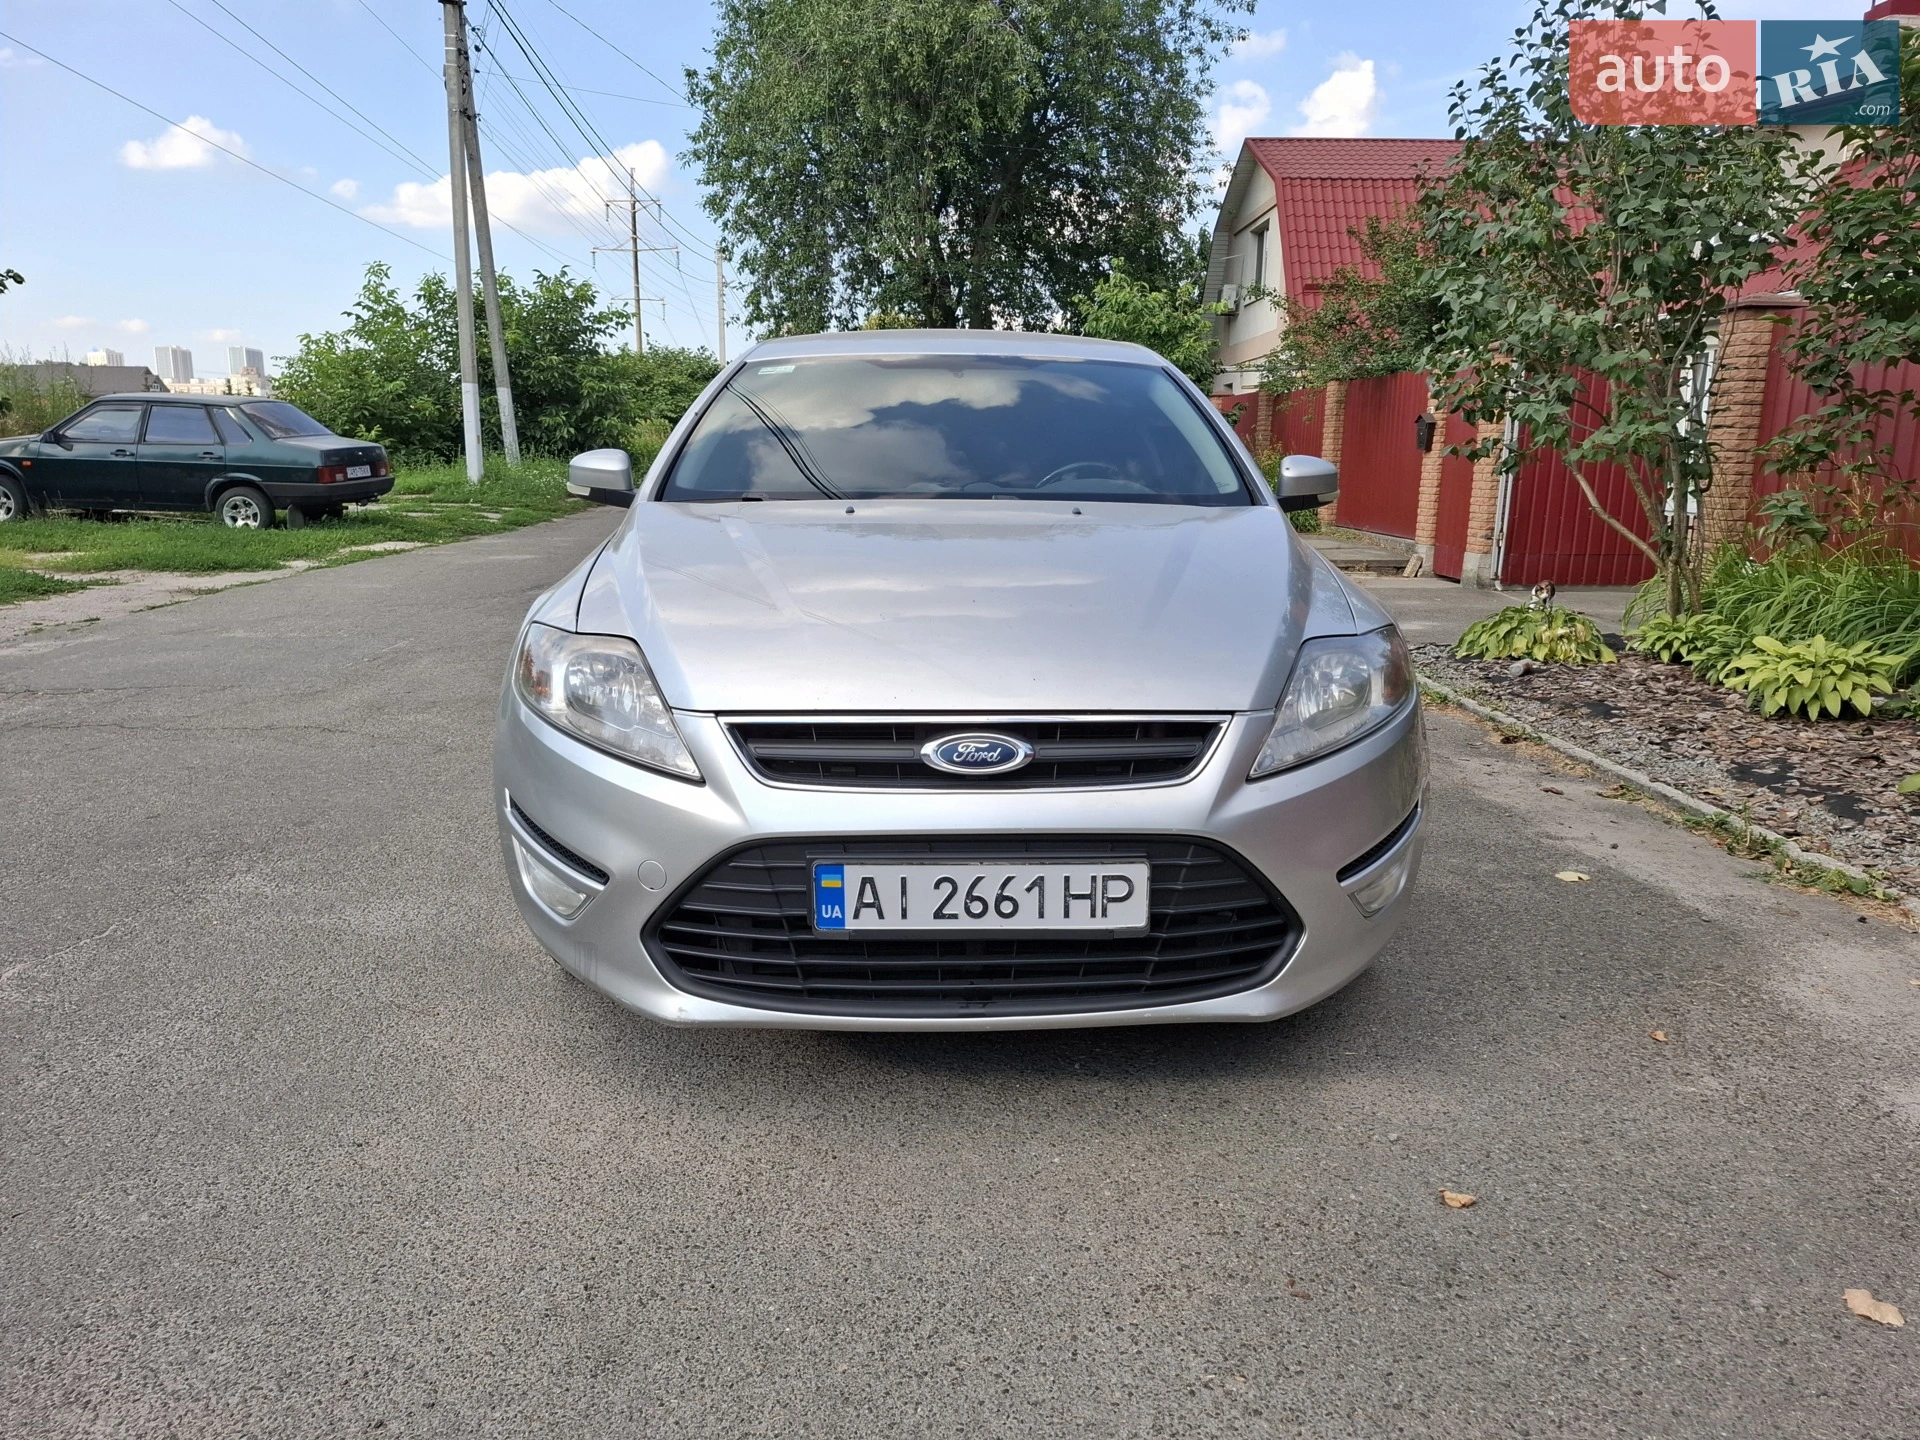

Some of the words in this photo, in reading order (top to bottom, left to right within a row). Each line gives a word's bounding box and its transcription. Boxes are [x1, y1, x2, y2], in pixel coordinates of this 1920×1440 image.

[953, 742, 1002, 763] Ford
[852, 875, 907, 920] AI
[932, 875, 1046, 920] 2661
[1063, 874, 1135, 919] HP
[821, 905, 843, 919] UA
